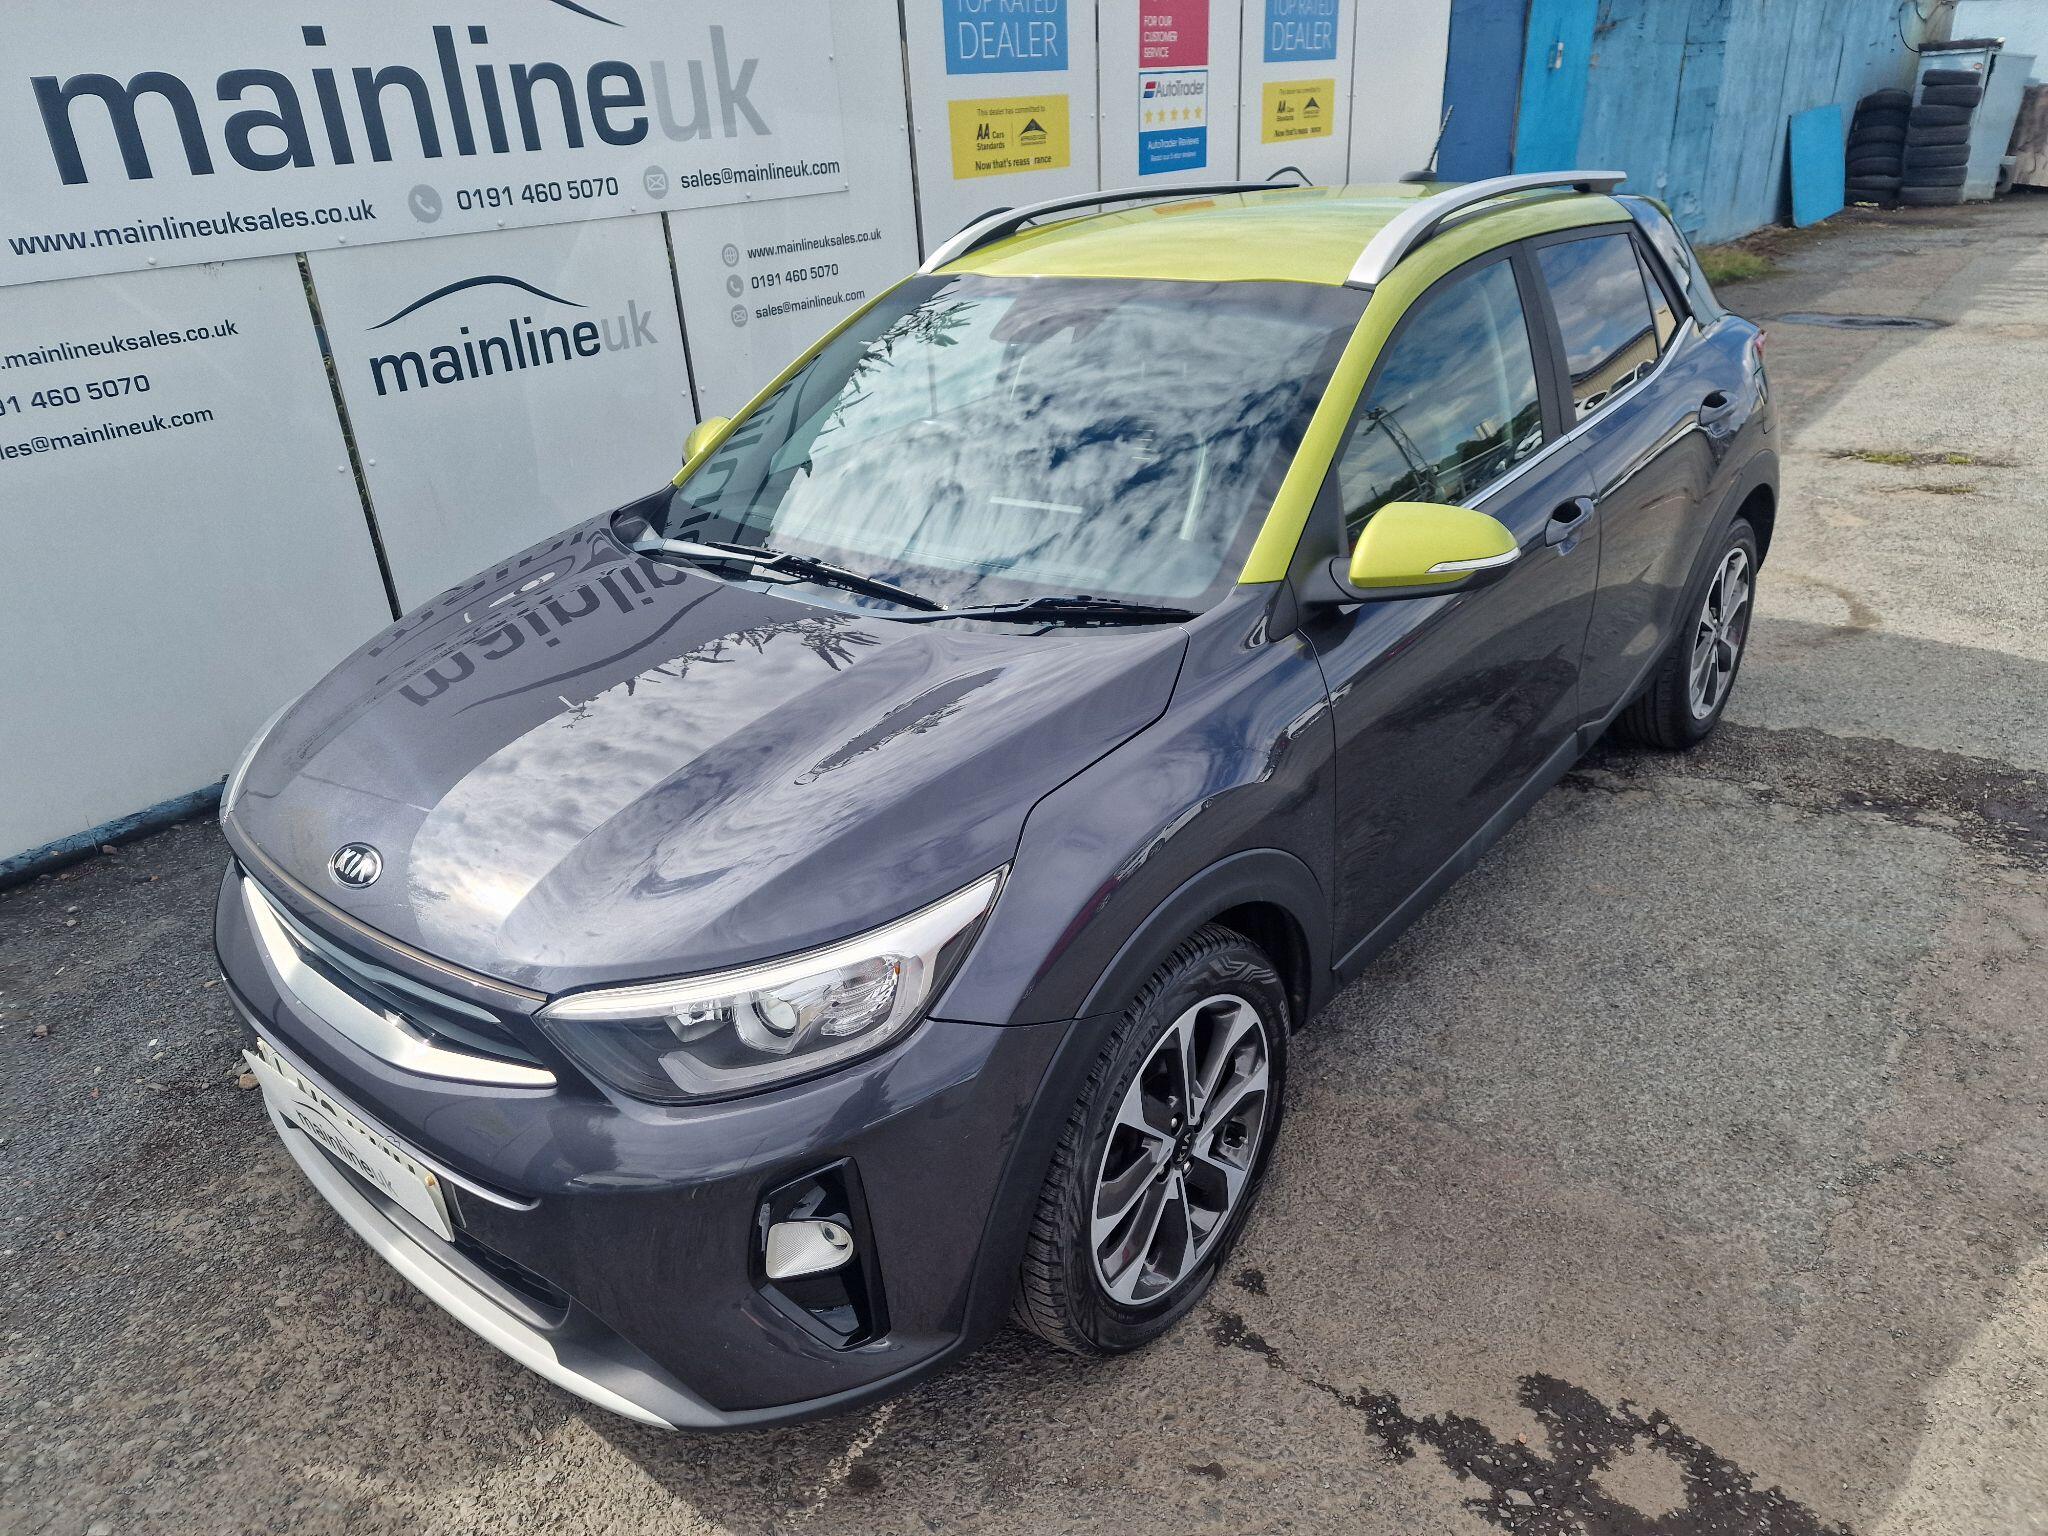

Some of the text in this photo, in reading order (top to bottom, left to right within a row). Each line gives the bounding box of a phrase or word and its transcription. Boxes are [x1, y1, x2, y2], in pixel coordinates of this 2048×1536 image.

[958, 21, 1059, 59] DEALER
[1272, 21, 1332, 51] DEALER
[1155, 80, 1205, 98] AutoTrader
[976, 141, 1006, 151] Standards
[977, 122, 1005, 140] AA Cars
[975, 160, 992, 171] Now
[993, 158, 1012, 168] that's
[8, 158, 840, 256] www.mainlineuksales.co.uk 0191 460 5070 sales@mainlineuk.com
[747, 228, 882, 259] www.mainlineuksales.co.uk
[751, 263, 839, 289] 0191 460 5070
[755, 290, 866, 319] sales@mainlineuk.com
[31, 386, 81, 409] 460
[86, 374, 151, 400] 5070
[334, 848, 372, 883] KIA
[1176, 1131, 1191, 1162] KIA
